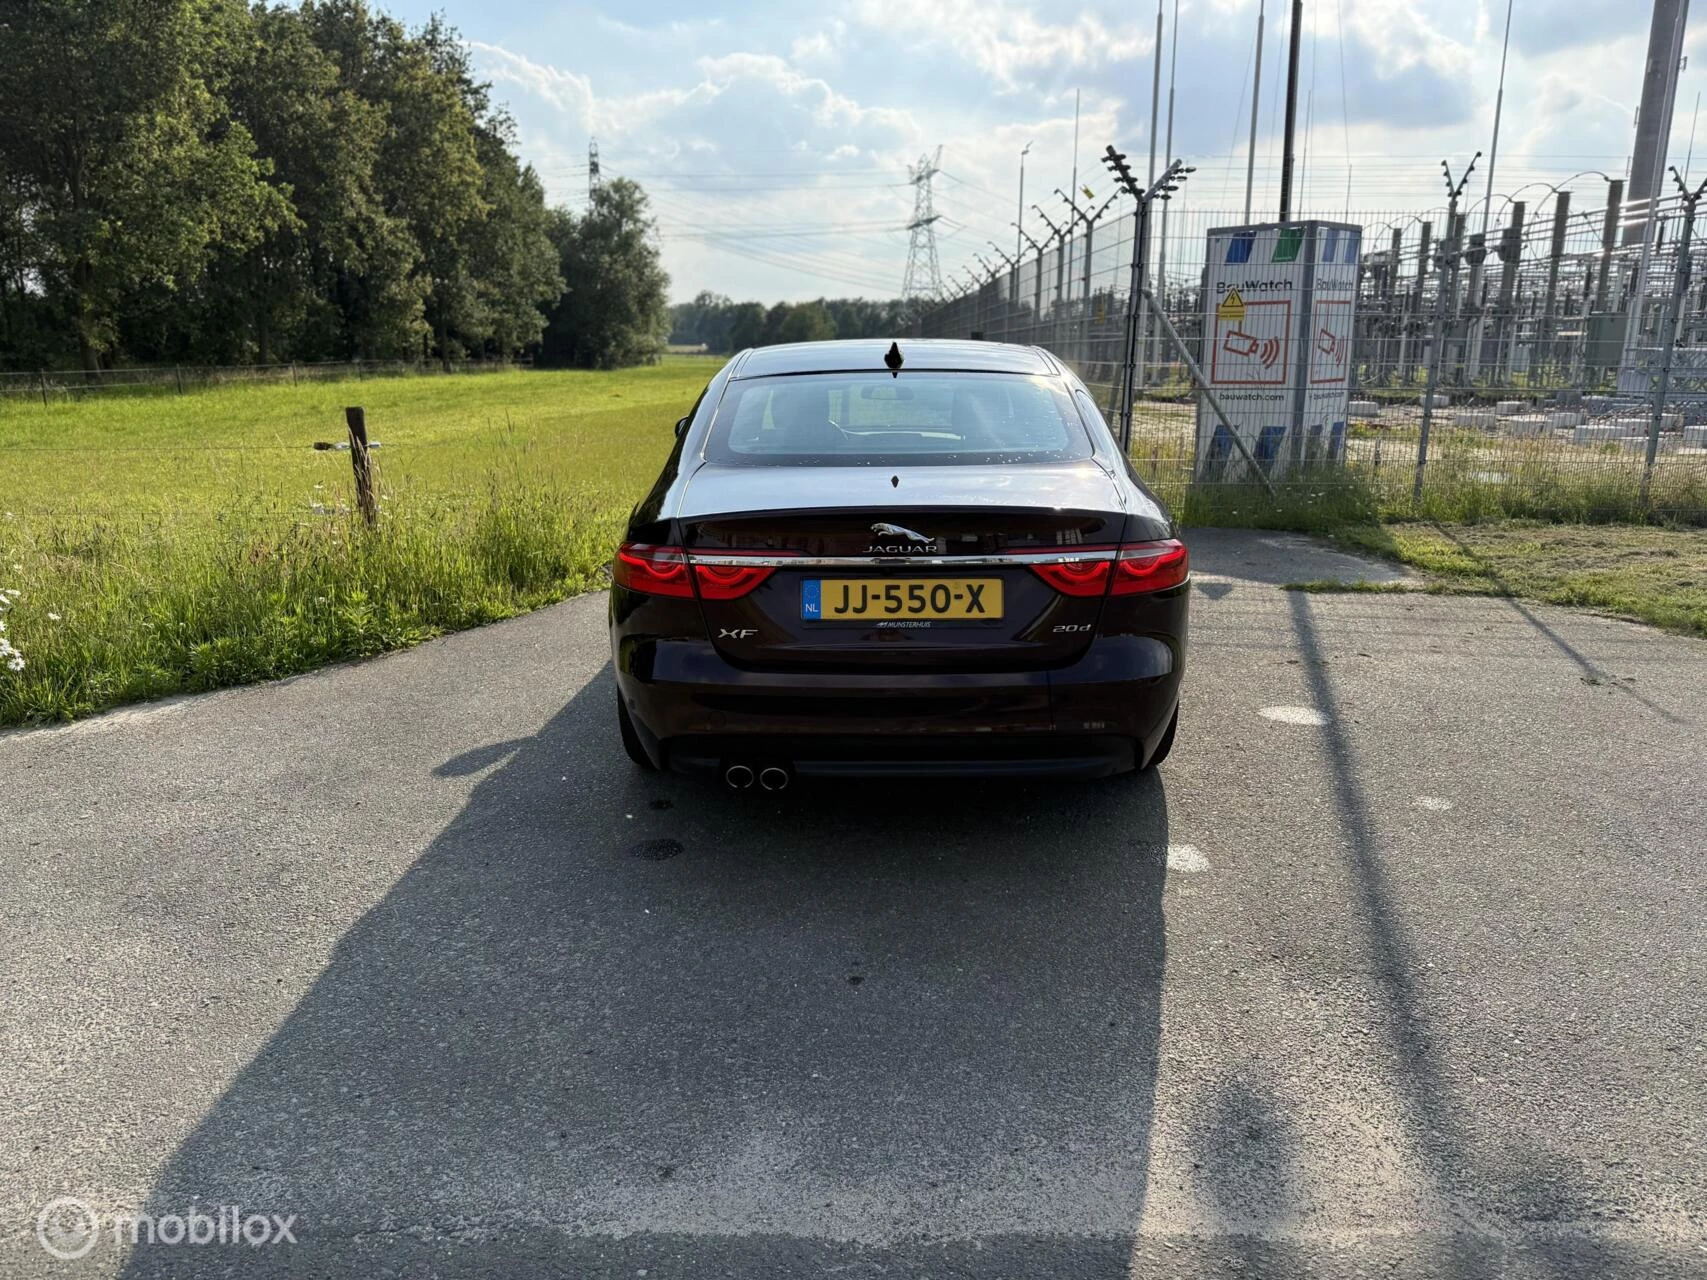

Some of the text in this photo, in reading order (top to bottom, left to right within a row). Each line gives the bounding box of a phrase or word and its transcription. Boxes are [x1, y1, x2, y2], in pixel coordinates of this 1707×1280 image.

[1216, 279, 1293, 294] BauWatch
[1220, 392, 1284, 401] bauwatch.com
[863, 545, 937, 553] JAGUAR
[834, 583, 986, 614] JJ-550-X
[805, 603, 819, 613] NL
[718, 628, 758, 638] XF
[1053, 624, 1091, 632] 20d
